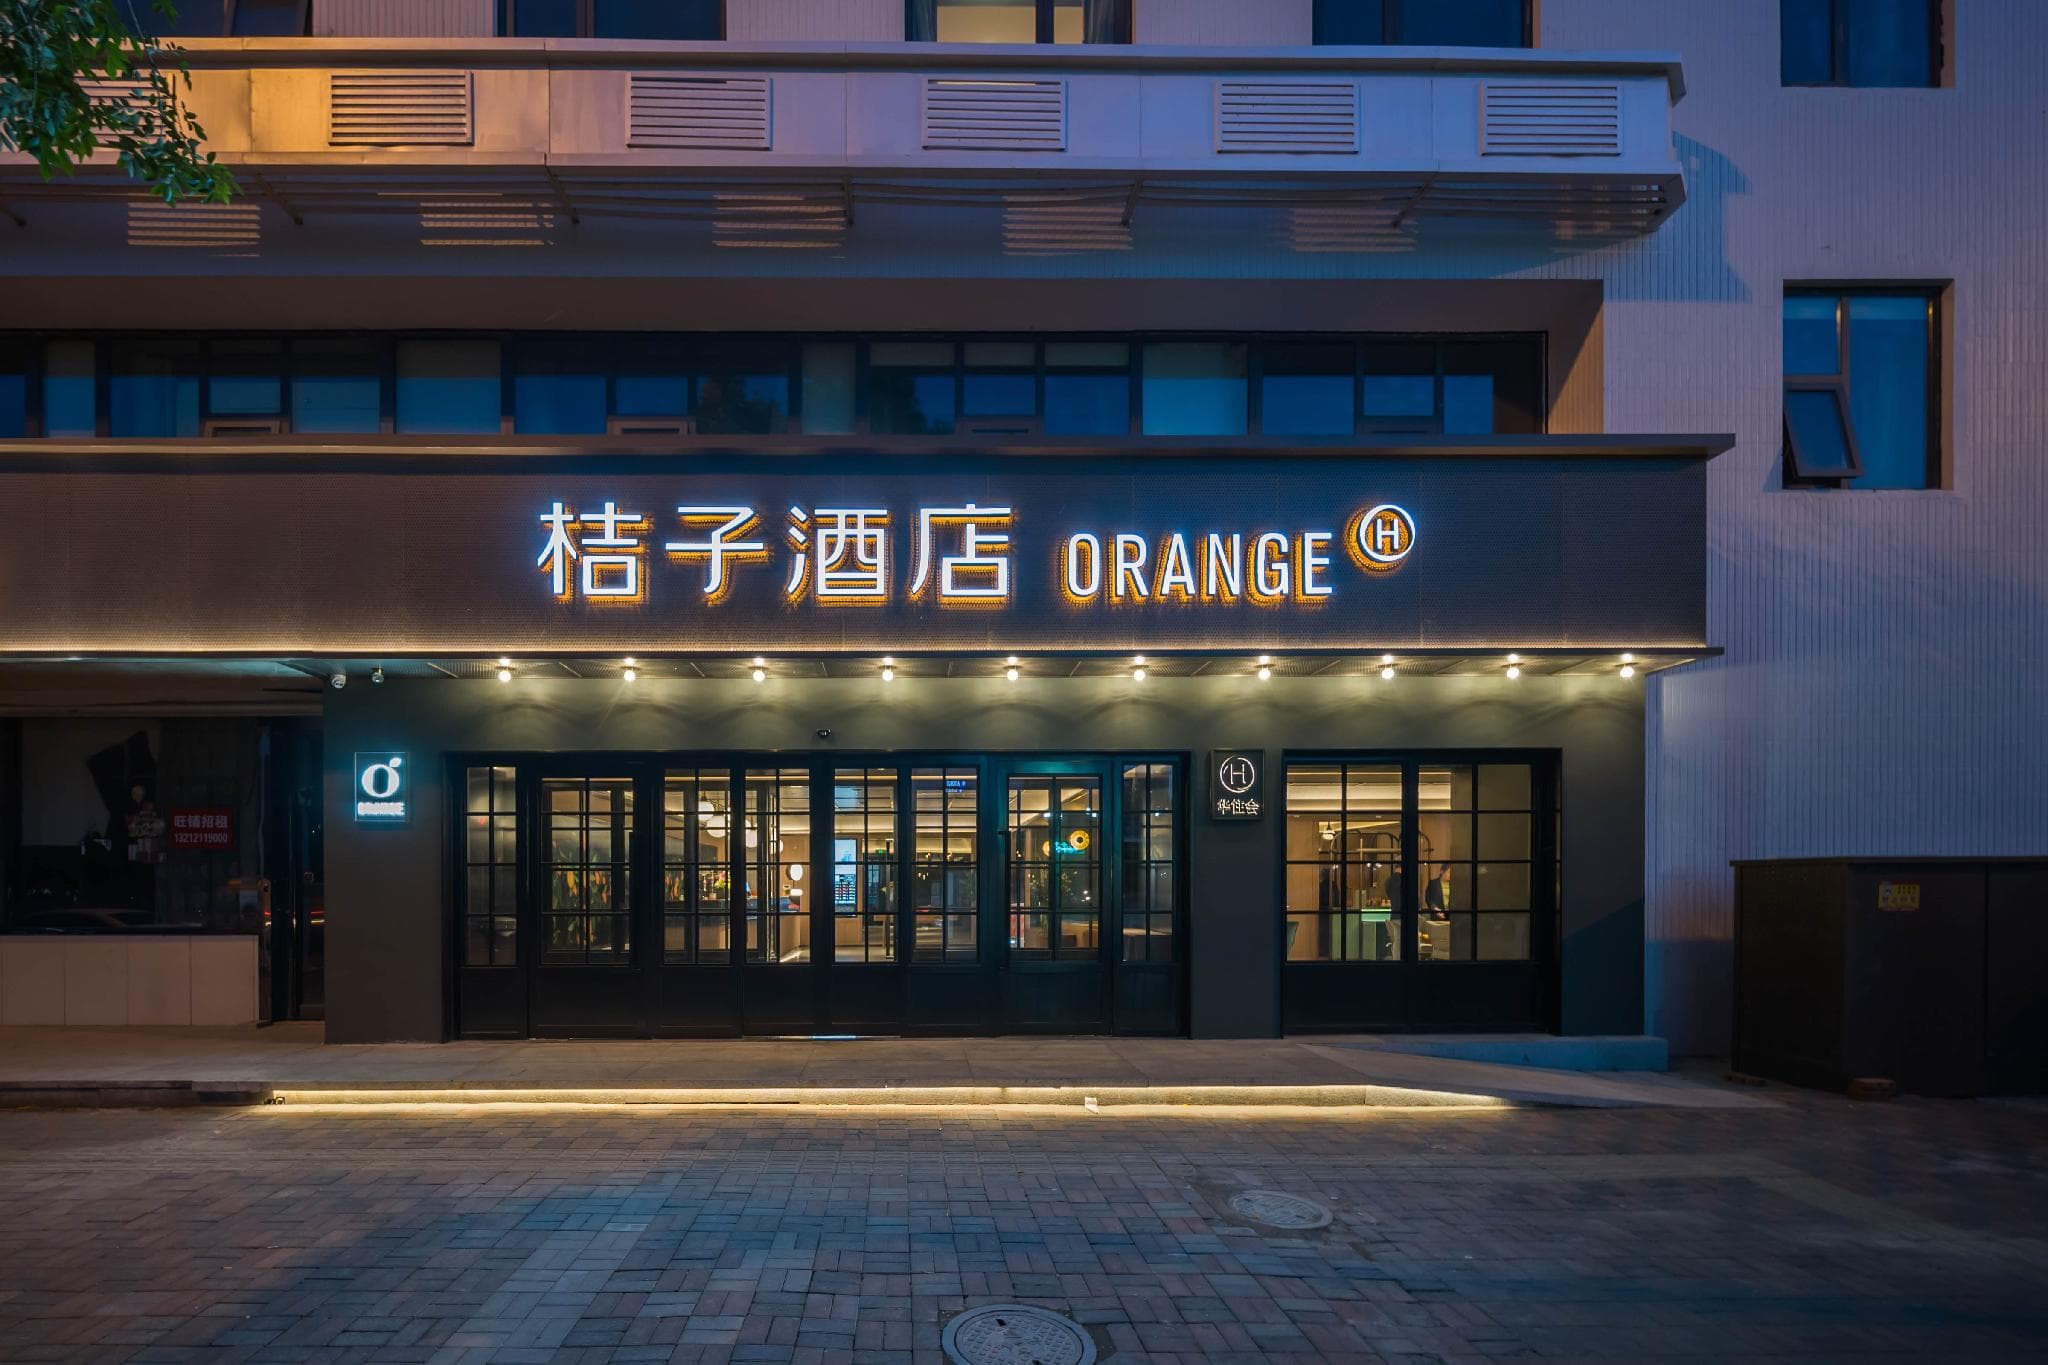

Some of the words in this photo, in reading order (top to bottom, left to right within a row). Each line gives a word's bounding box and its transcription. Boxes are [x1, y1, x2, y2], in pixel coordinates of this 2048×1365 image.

[537, 502, 1011, 597] 桔子酒店
[1066, 531, 1333, 597] ORANGE
[174, 815, 228, 828] 旺铺招租
[1217, 798, 1260, 815] 华住会
